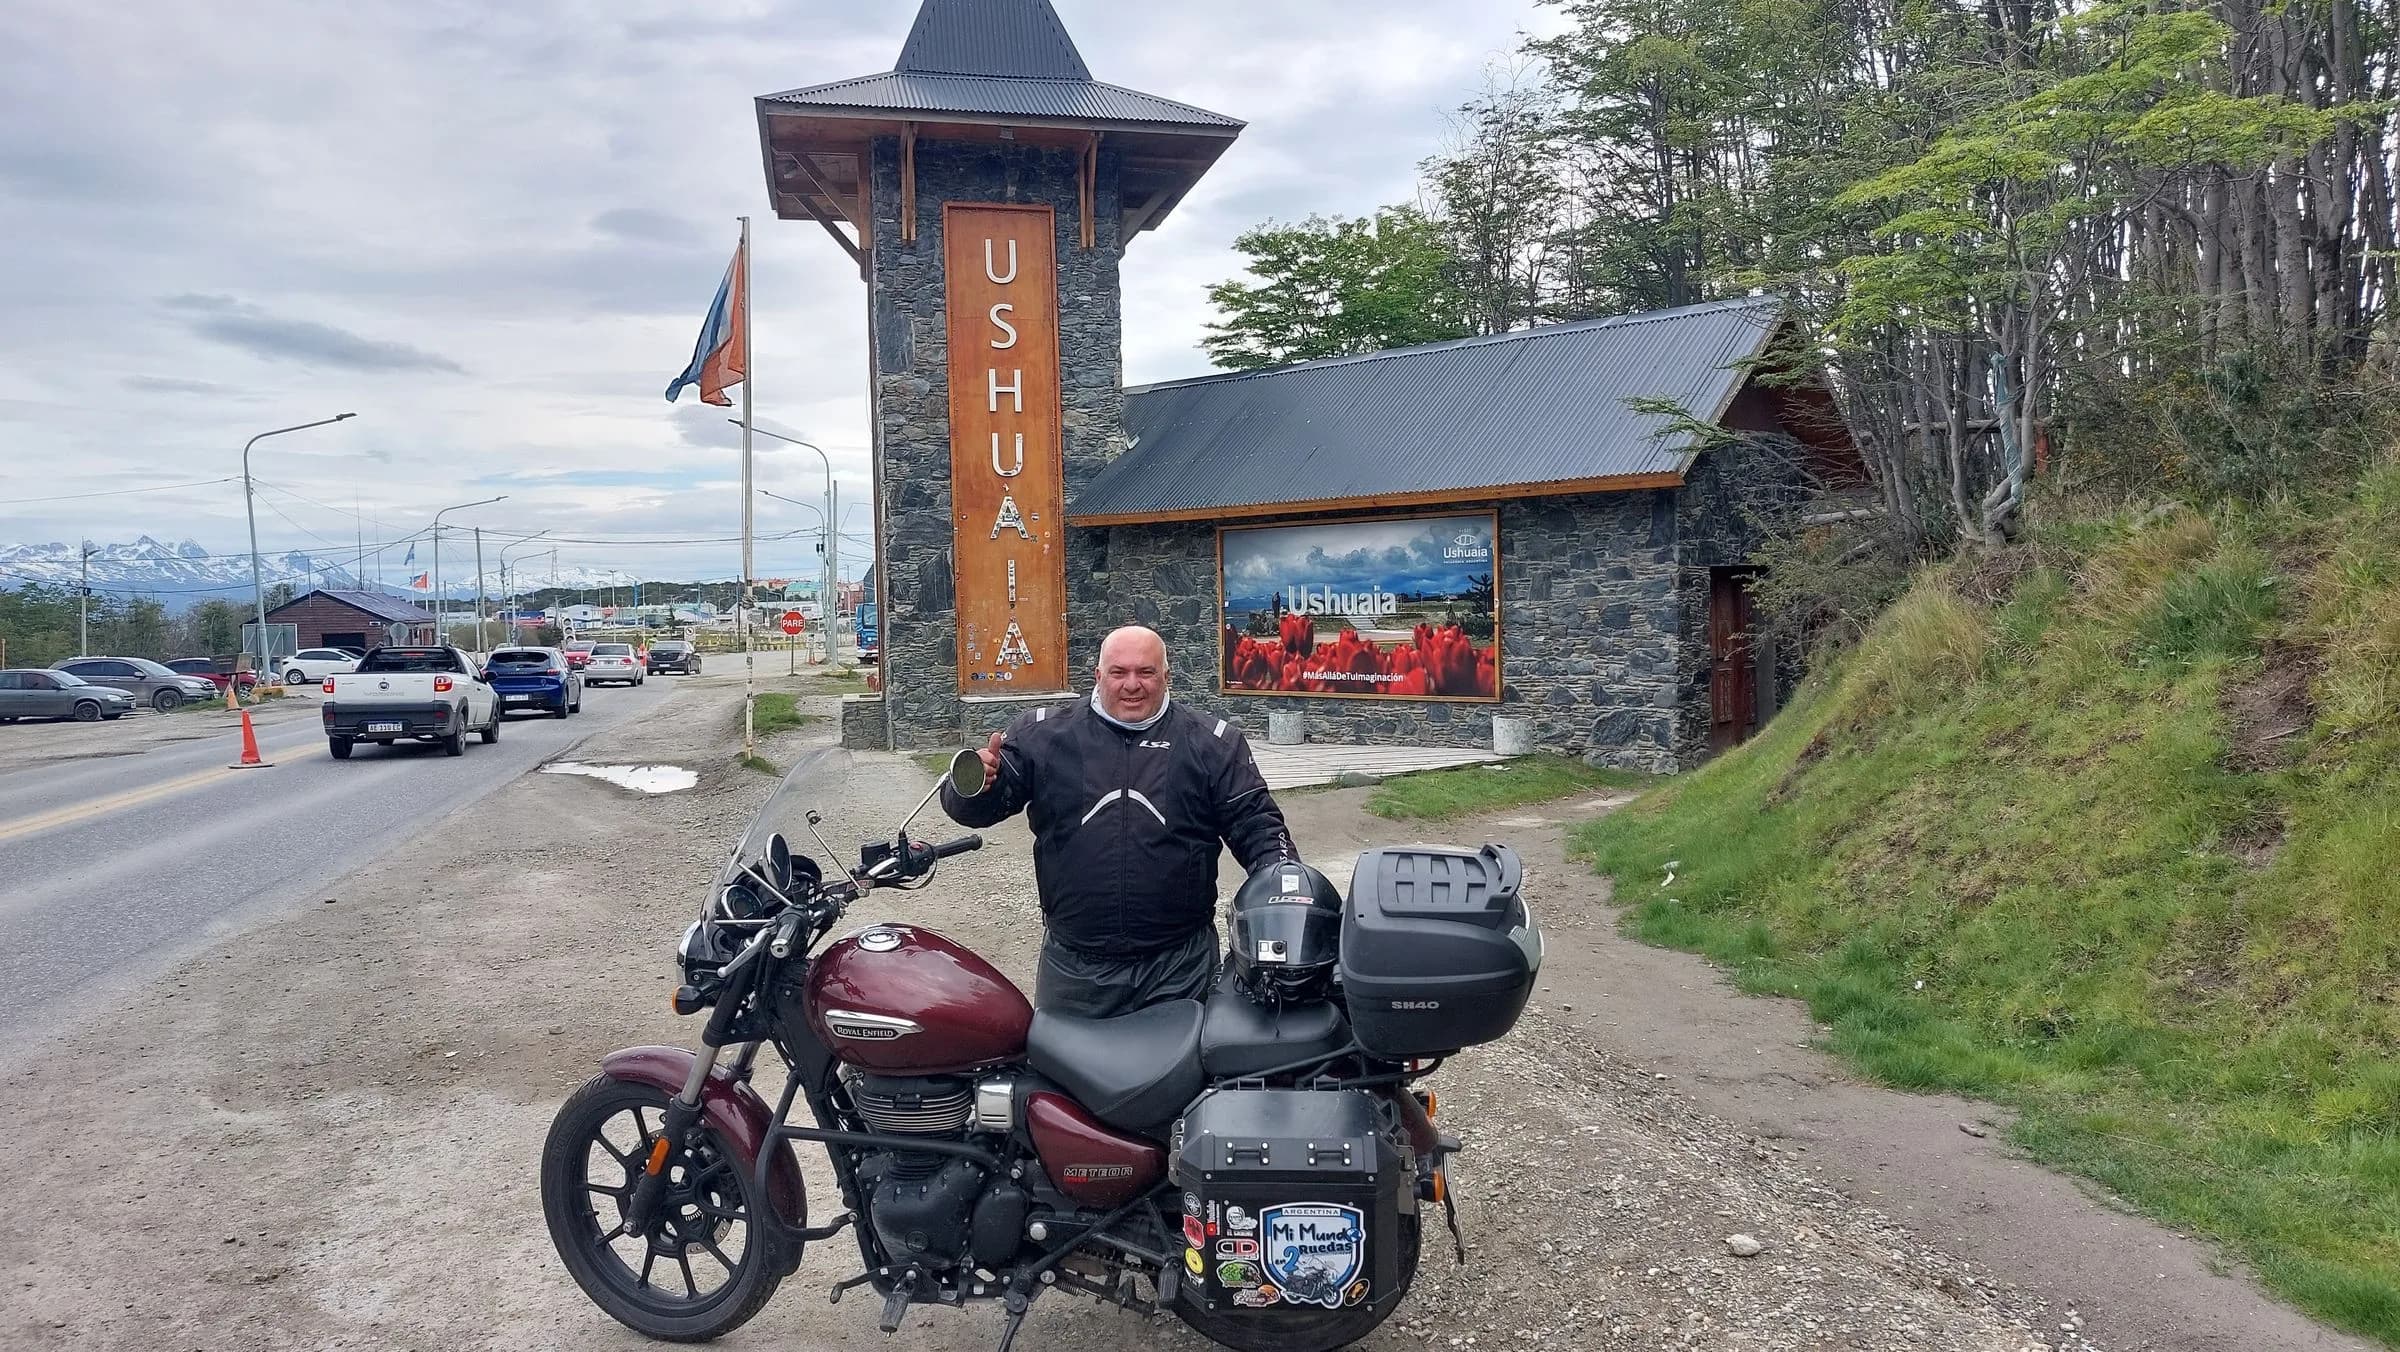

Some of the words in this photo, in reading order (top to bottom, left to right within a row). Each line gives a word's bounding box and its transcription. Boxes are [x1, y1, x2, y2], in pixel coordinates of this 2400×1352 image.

[984, 238, 1034, 665] USHUAIA
[1443, 546, 1488, 559] Ushuaia
[1288, 584, 1397, 616] Ushuaia
[782, 619, 804, 628] PARE
[1302, 671, 1404, 684] #MásAlláDeTuImaginación
[1139, 740, 1171, 750] LS2
[1391, 1001, 1440, 1009] SH40
[837, 1026, 862, 1036] ROYAL
[862, 1029, 894, 1037] ENFIELD
[1063, 1166, 1133, 1177] METEOR
[1272, 1223, 1294, 1241] Mi
[1282, 1245, 1300, 1272] 2
[1298, 1241, 1353, 1254] Ruedas
